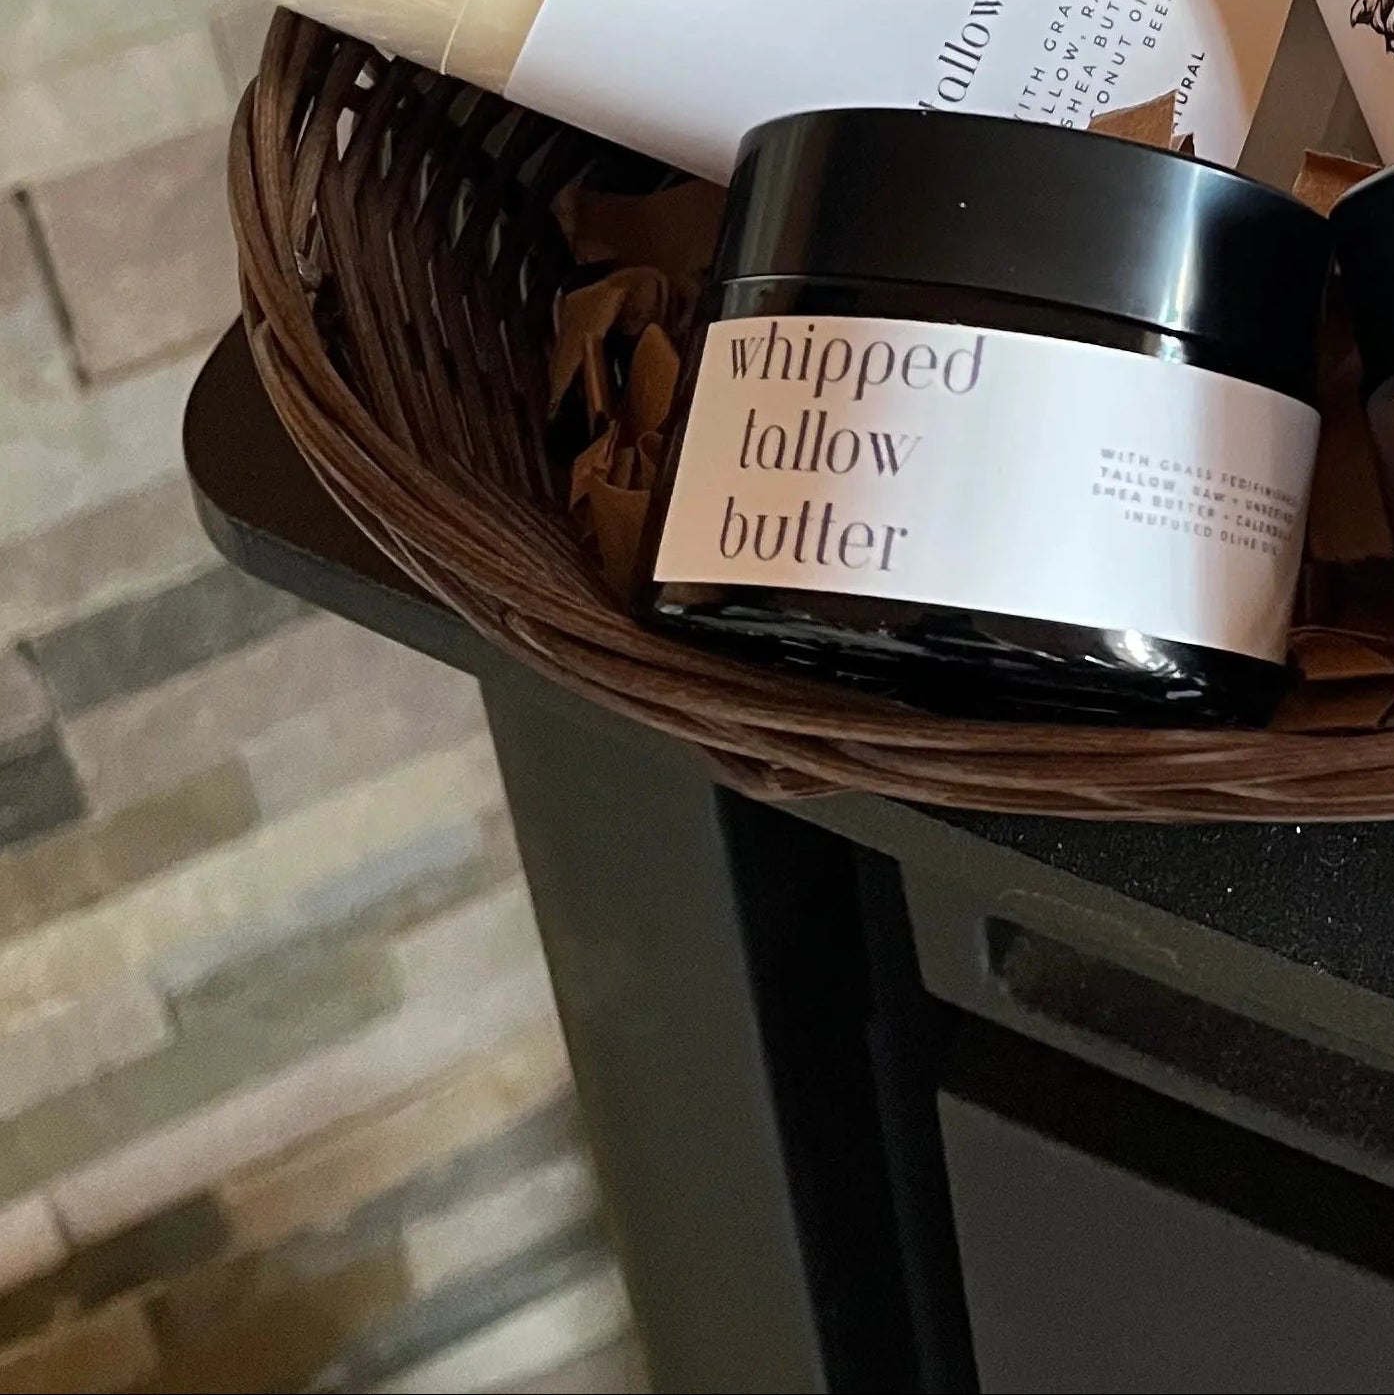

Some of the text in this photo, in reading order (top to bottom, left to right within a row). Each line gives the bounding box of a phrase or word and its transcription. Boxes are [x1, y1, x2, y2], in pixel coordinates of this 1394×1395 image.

[1013, 66, 1046, 122] ITH
[1041, 34, 1087, 122] LLOW,
[1060, 63, 1096, 130] SHEA
[729, 320, 987, 401] whipped
[738, 408, 924, 478] tallow
[1101, 448, 1150, 467] WITH
[719, 496, 909, 573] butter
